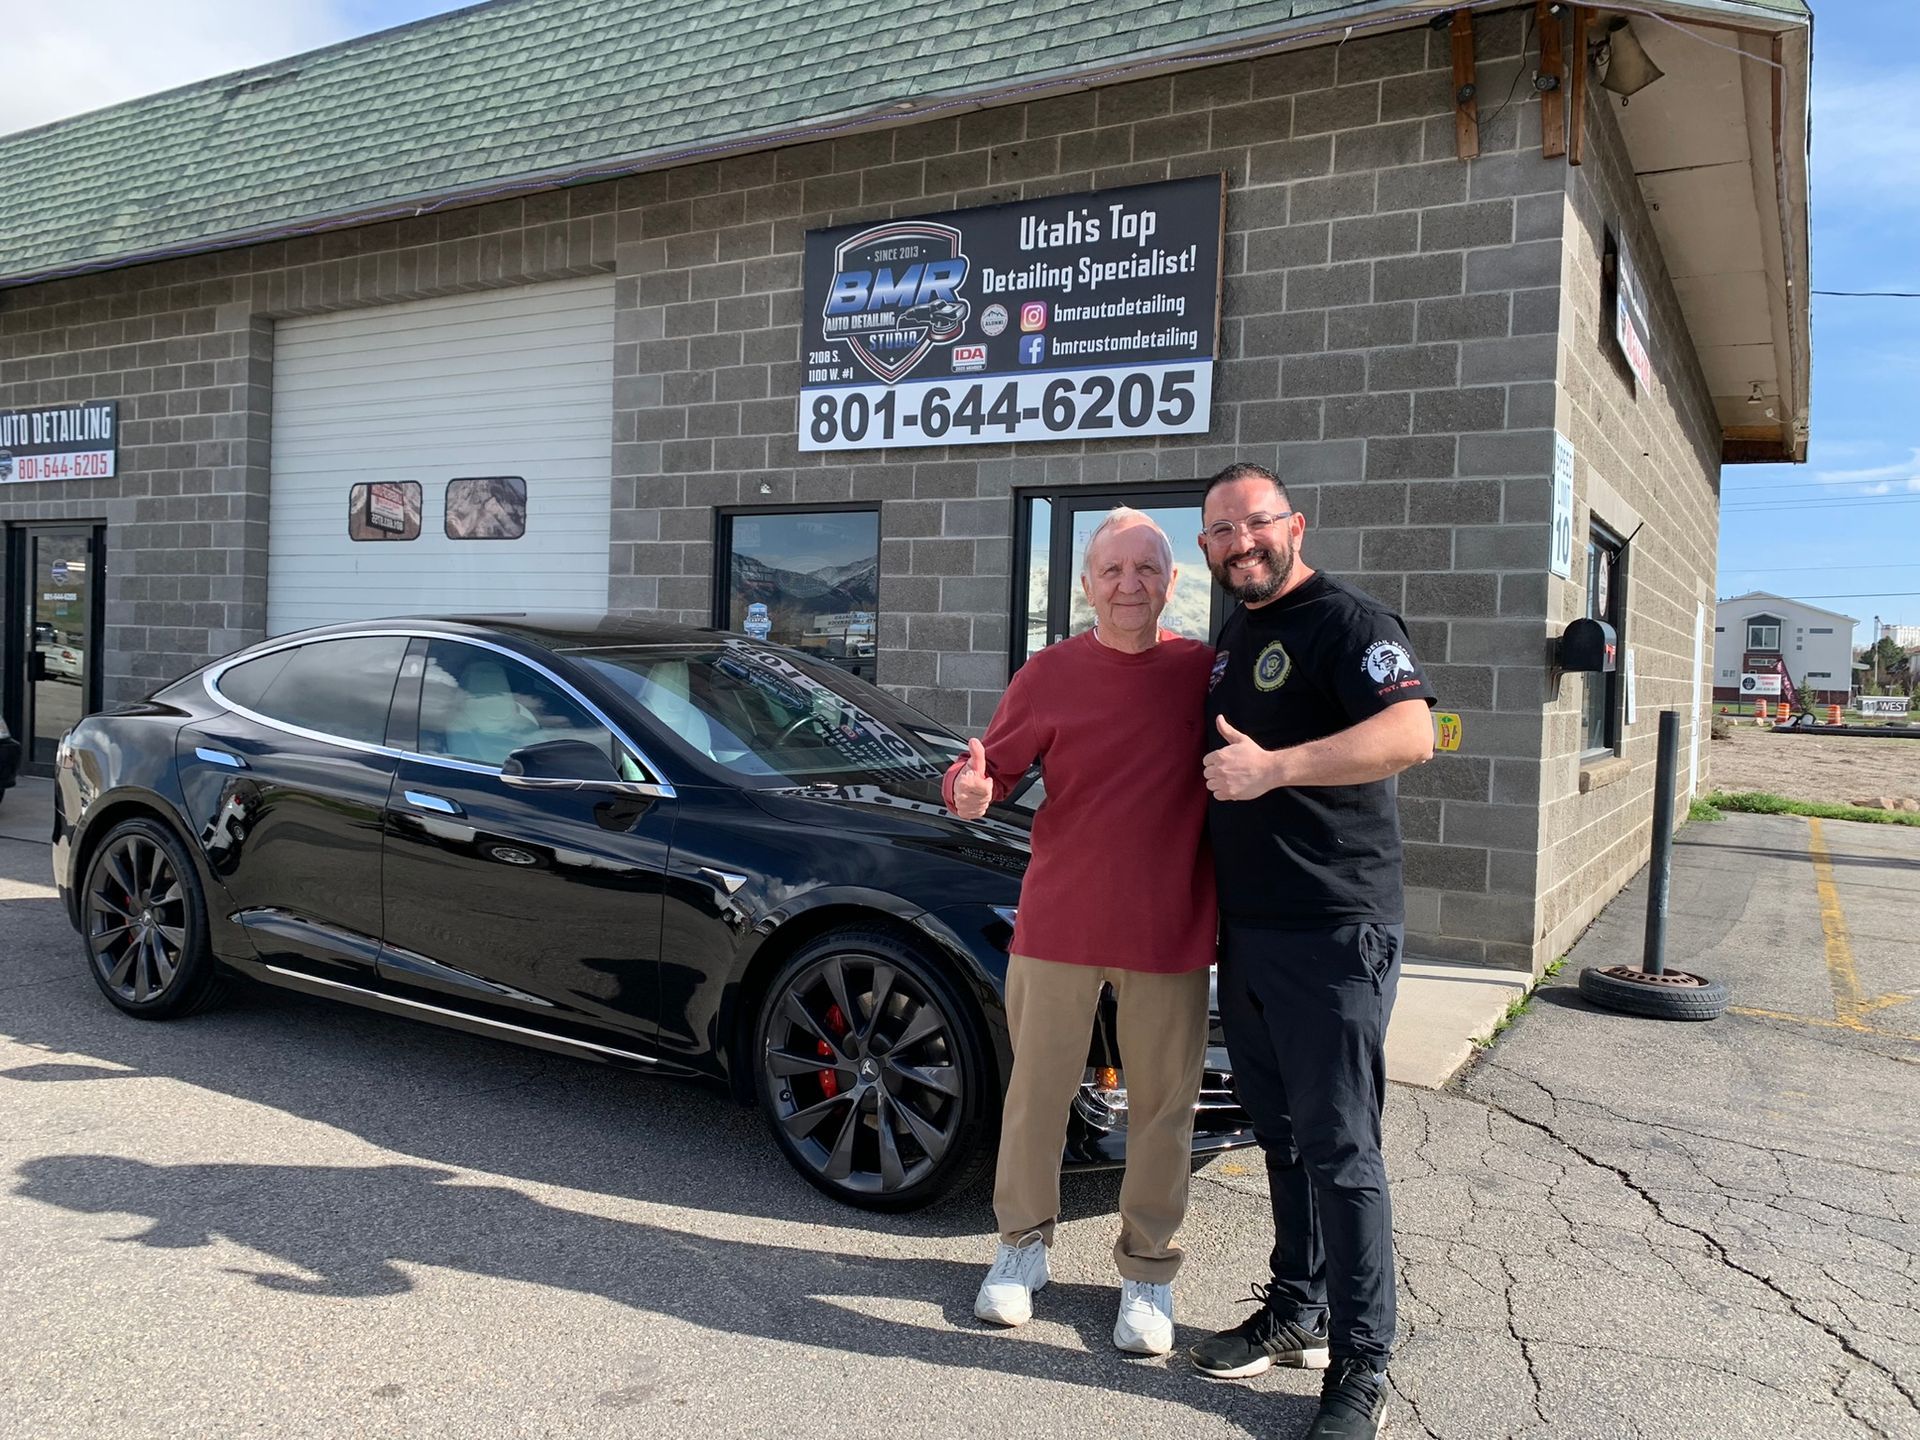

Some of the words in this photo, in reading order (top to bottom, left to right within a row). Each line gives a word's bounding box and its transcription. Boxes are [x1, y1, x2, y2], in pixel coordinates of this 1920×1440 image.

[1020, 209, 1100, 251] Utah's
[1109, 203, 1156, 247] Top
[874, 250, 898, 262] SINCE
[899, 245, 919, 258] 2013
[982, 262, 1073, 294] Detailing
[1078, 244, 1197, 290] Specialist!
[826, 258, 966, 315] BMR
[826, 314, 849, 332] AUTO
[851, 311, 895, 328] DETAILING
[1054, 293, 1186, 323] bmrautodetailing
[869, 330, 918, 352] STUDIO
[955, 347, 984, 361] IDA
[1052, 326, 1198, 356] bmrcustomdetailing
[809, 350, 831, 364] 2108
[832, 349, 841, 362] S.
[808, 369, 827, 382] 1100
[829, 368, 840, 380] W.
[842, 366, 853, 379] #1
[810, 369, 1195, 443] 801-644-6205
[0, 414, 29, 447] UTO
[32, 406, 111, 444] DETAILING
[18, 453, 108, 480] 801-644-6205
[1556, 443, 1572, 480] SPEED
[1556, 512, 1570, 565] 10
[1360, 656, 1368, 672] THE
[1365, 640, 1390, 655] DETAIL
[1880, 701, 1908, 711] WEST
